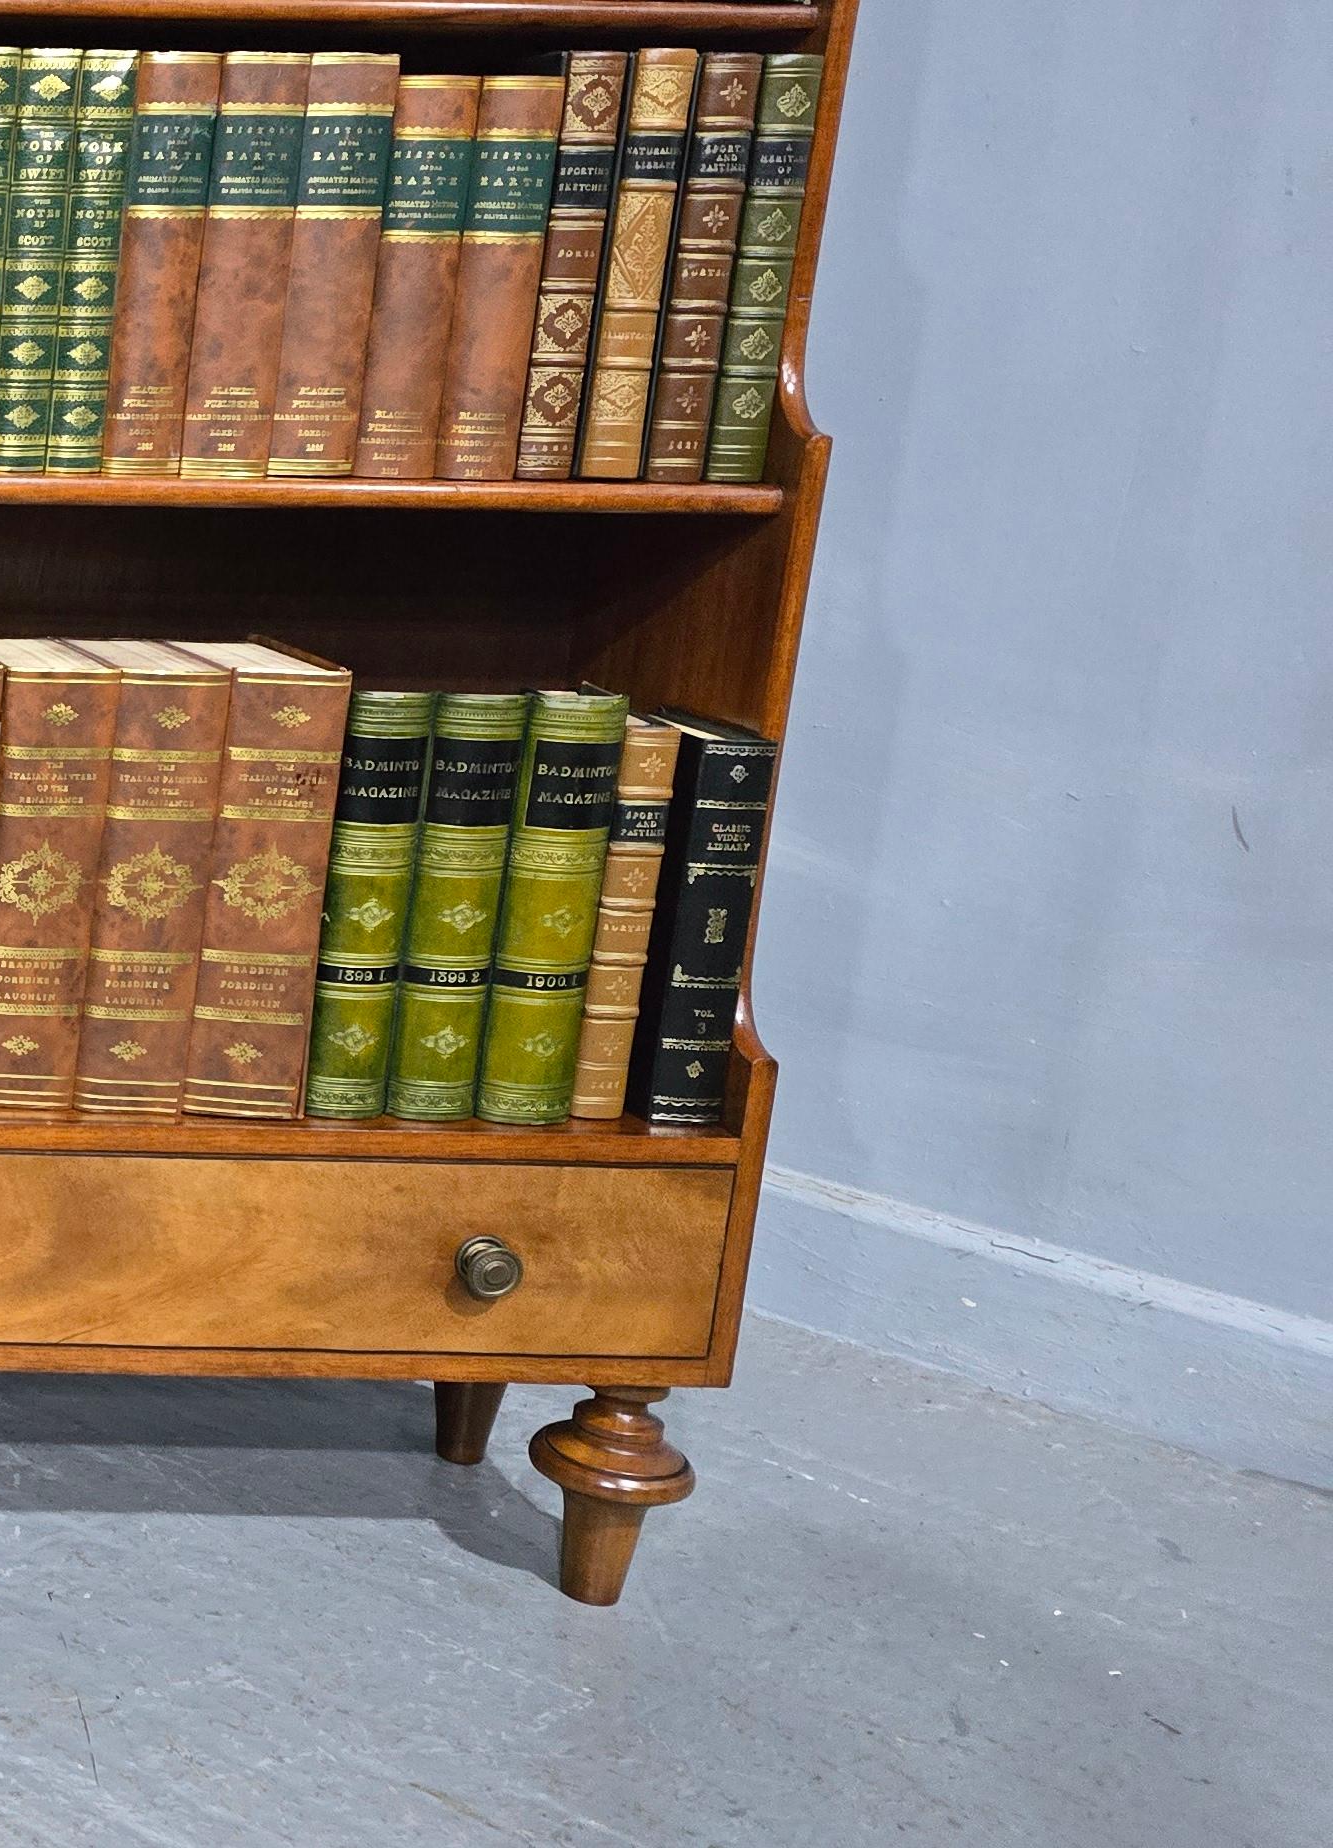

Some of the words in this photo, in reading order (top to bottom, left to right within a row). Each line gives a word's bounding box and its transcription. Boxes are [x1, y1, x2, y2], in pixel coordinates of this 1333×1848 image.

[95, 155, 113, 165] OF
[480, 151, 550, 160] HISTORY
[79, 169, 124, 180] SWIFT
[393, 176, 458, 186] EARTH
[480, 177, 544, 188] EARTH
[75, 209, 119, 219] NOTES
[76, 236, 112, 247] SCOTT
[344, 786, 419, 799] MAGAZINE
[435, 787, 511, 800] MAGAZINE
[537, 791, 612, 805] MAGAZINE
[635, 820, 658, 828] AND
[711, 823, 751, 833] CLASSIC
[716, 834, 747, 842] VIDEO
[706, 842, 751, 852] LIBRARY
[429, 970, 469, 983] 1899.
[526, 975, 567, 988] 1900.
[696, 1022, 707, 1035] 3
